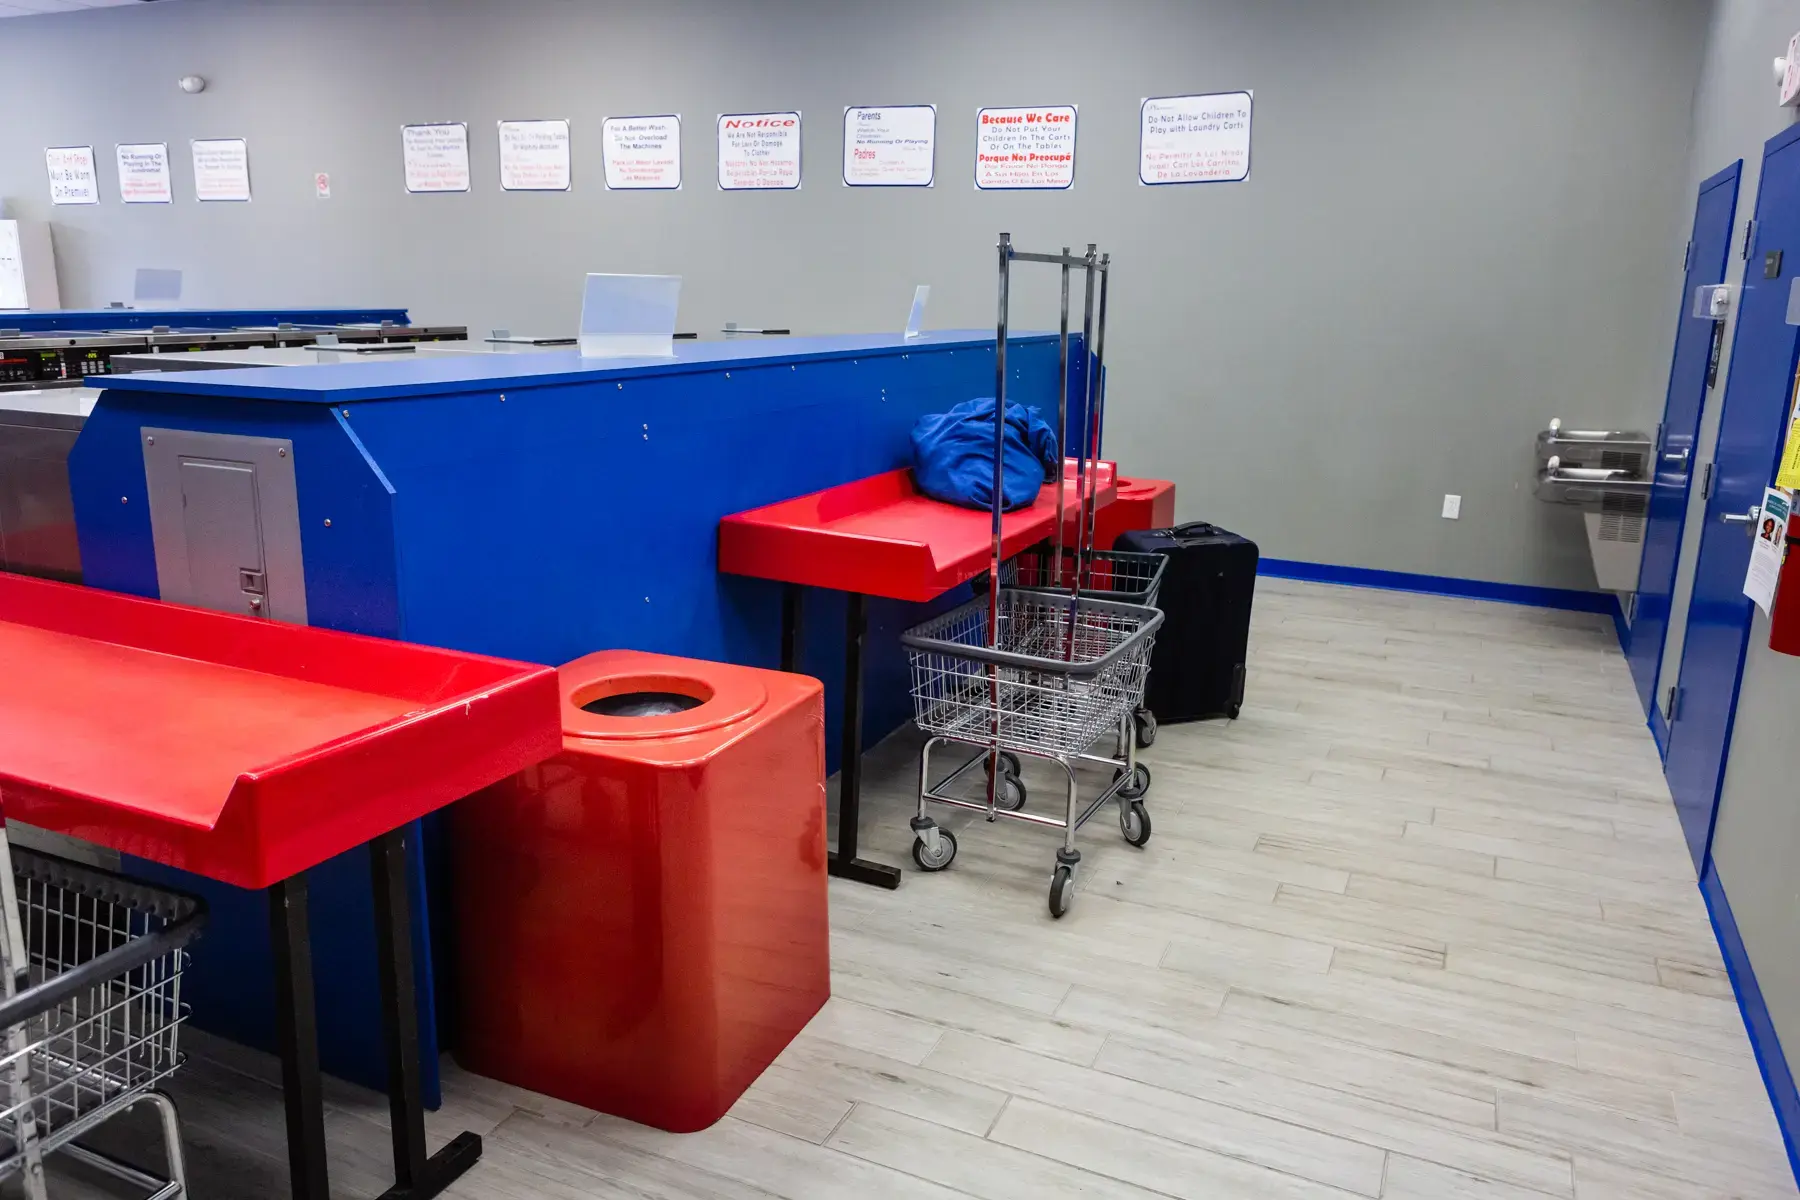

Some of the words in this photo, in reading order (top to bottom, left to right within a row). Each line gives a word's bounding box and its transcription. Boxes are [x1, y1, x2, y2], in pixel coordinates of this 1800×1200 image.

[857, 111, 882, 120] Parents
[982, 114, 1022, 124] Because
[1026, 113, 1042, 123] We
[1046, 113, 1070, 122] Care
[1148, 116, 1158, 124] Do
[1160, 115, 1174, 123] Not
[1178, 114, 1199, 122] Allow
[1201, 111, 1235, 120] Children
[1237, 110, 1247, 118] To
[726, 119, 795, 129] Notice
[1150, 126, 1167, 134] Play
[1170, 125, 1186, 133] with
[1188, 122, 1220, 132] Laundry
[1223, 121, 1244, 130] Carts
[761, 140, 783, 148] Damage
[854, 148, 876, 160] Padres
[979, 154, 1010, 163] Porque
[1012, 153, 1028, 162] Nos
[65, 169, 73, 180] Be
[1157, 170, 1168, 179] De
